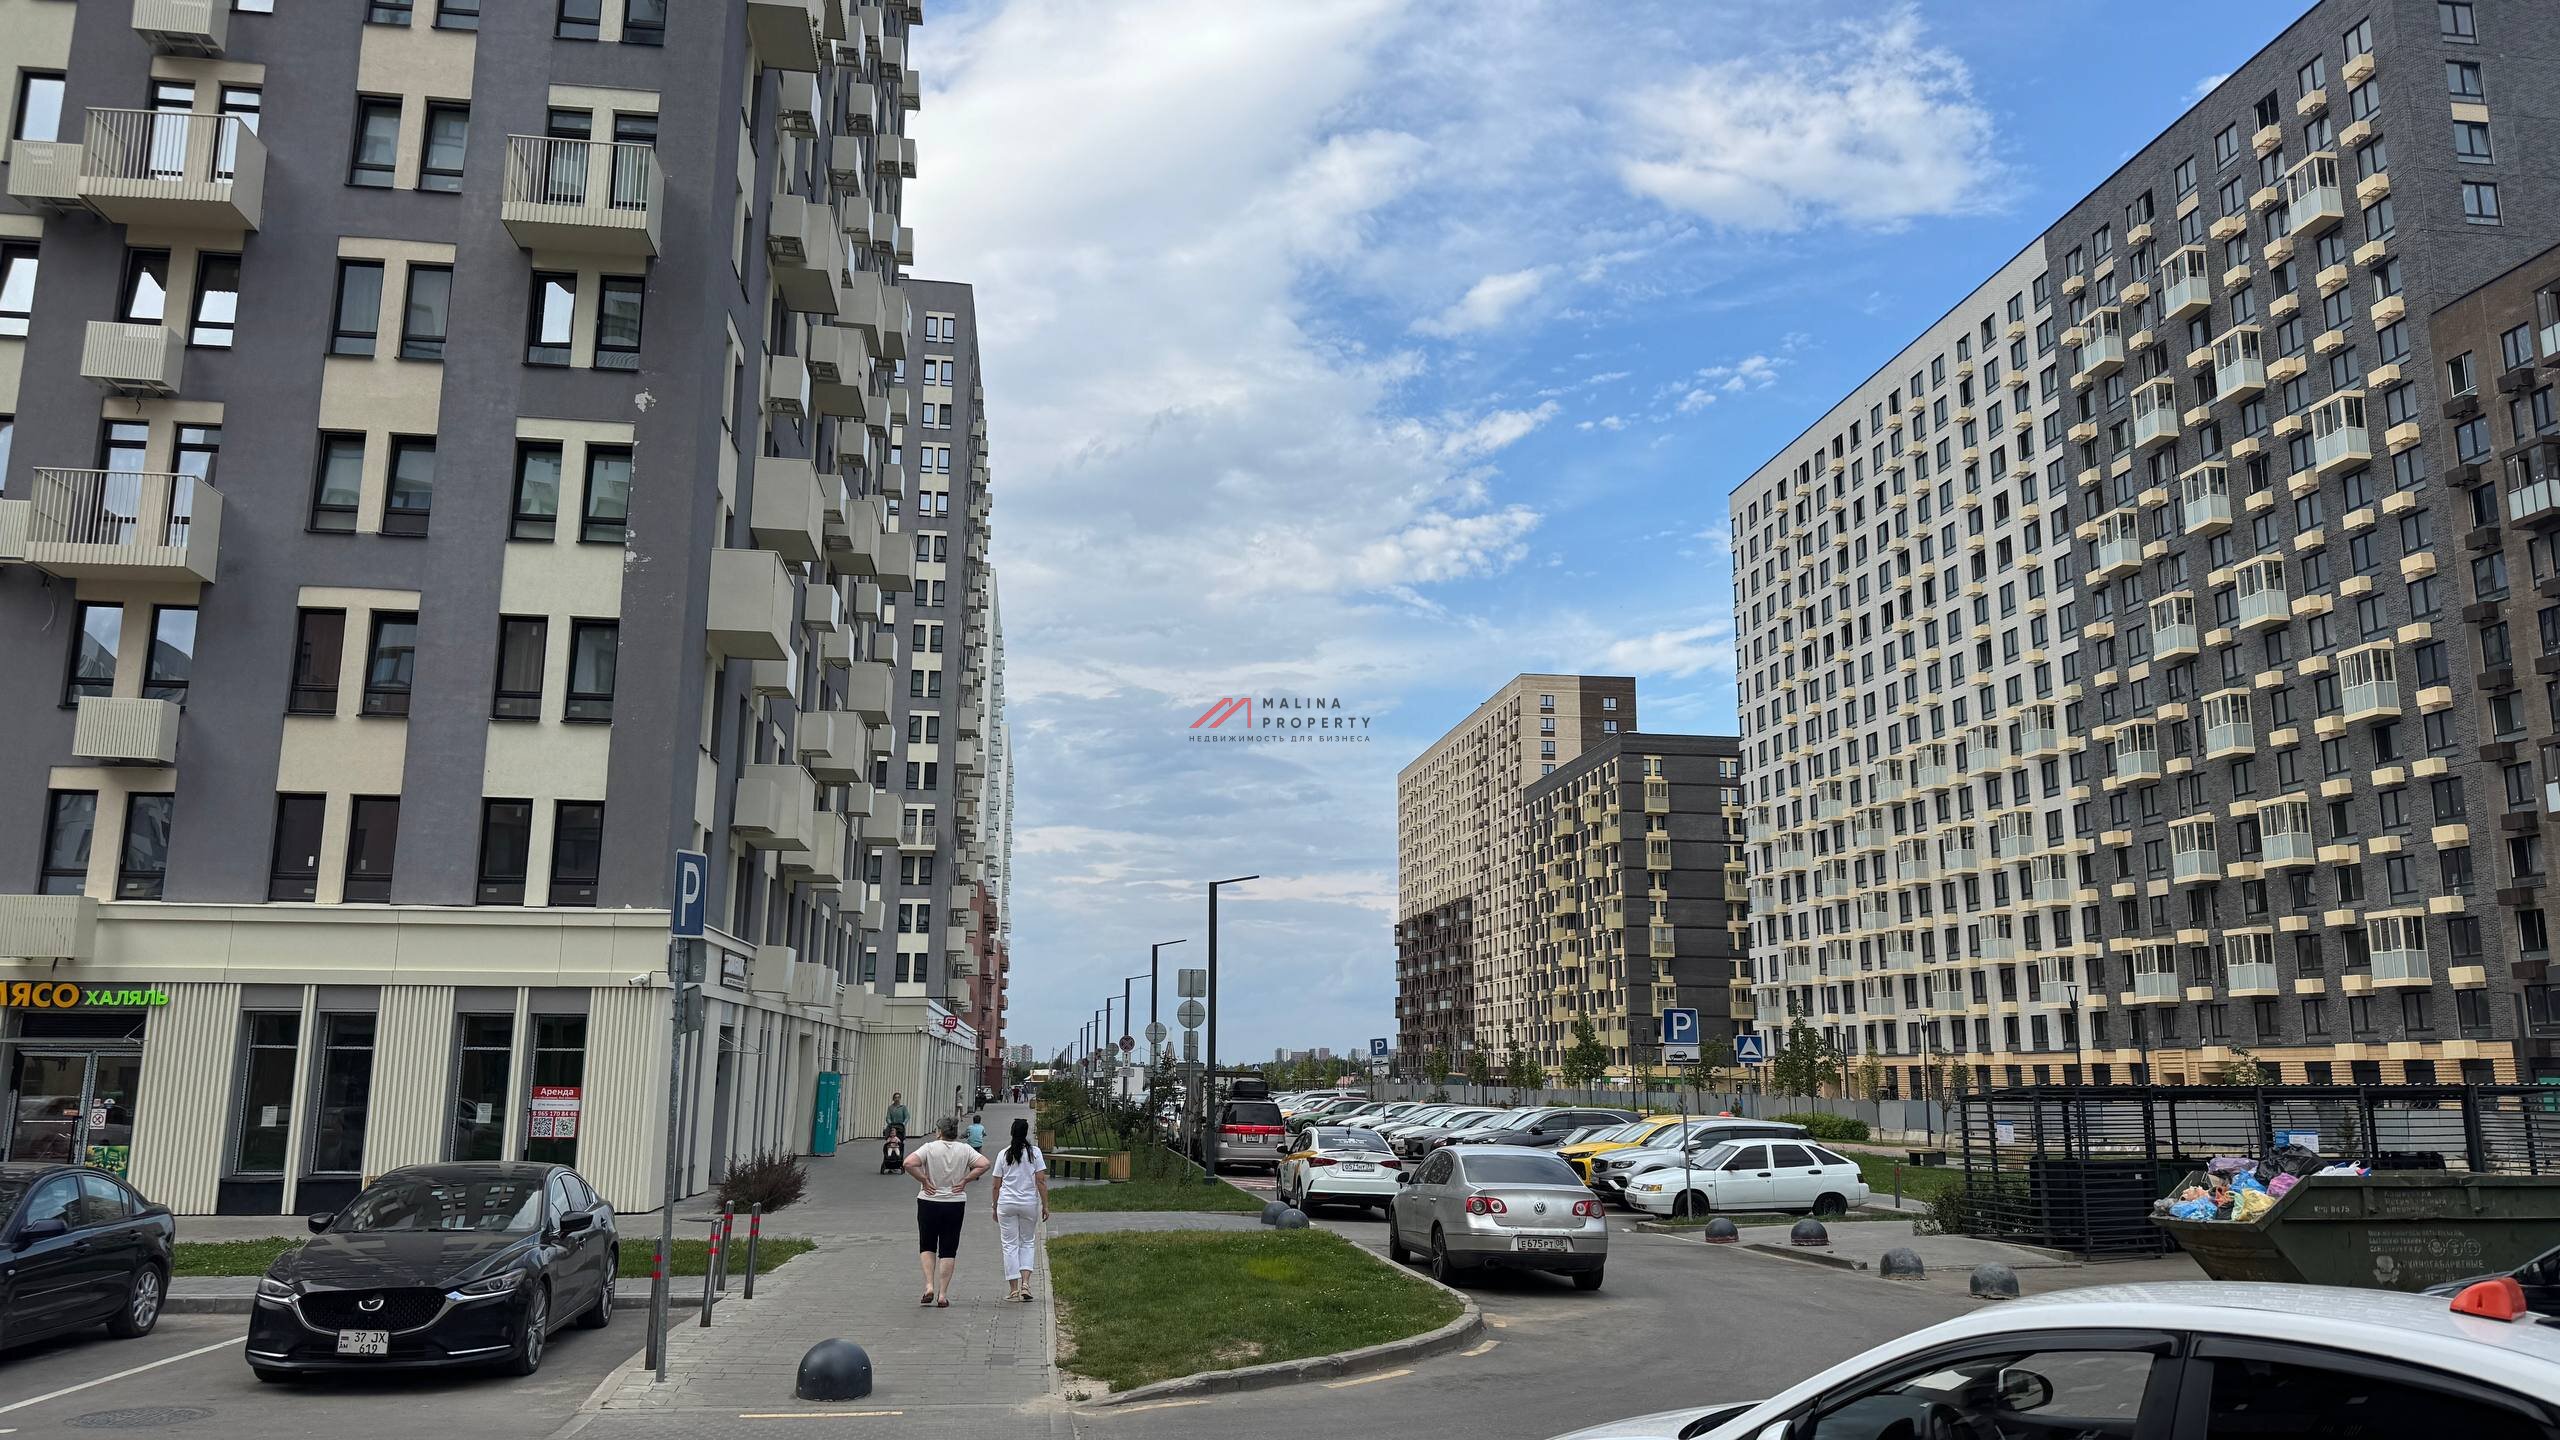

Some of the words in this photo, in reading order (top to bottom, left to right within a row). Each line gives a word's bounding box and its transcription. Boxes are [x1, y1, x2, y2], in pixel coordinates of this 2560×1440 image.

[84, 989, 170, 1006] ХАЛЯЛЬ
[1672, 1012, 1692, 1040] P
[1374, 1040, 1385, 1055] P
[540, 1087, 574, 1097] Аренда
[354, 1332, 367, 1343] 37
